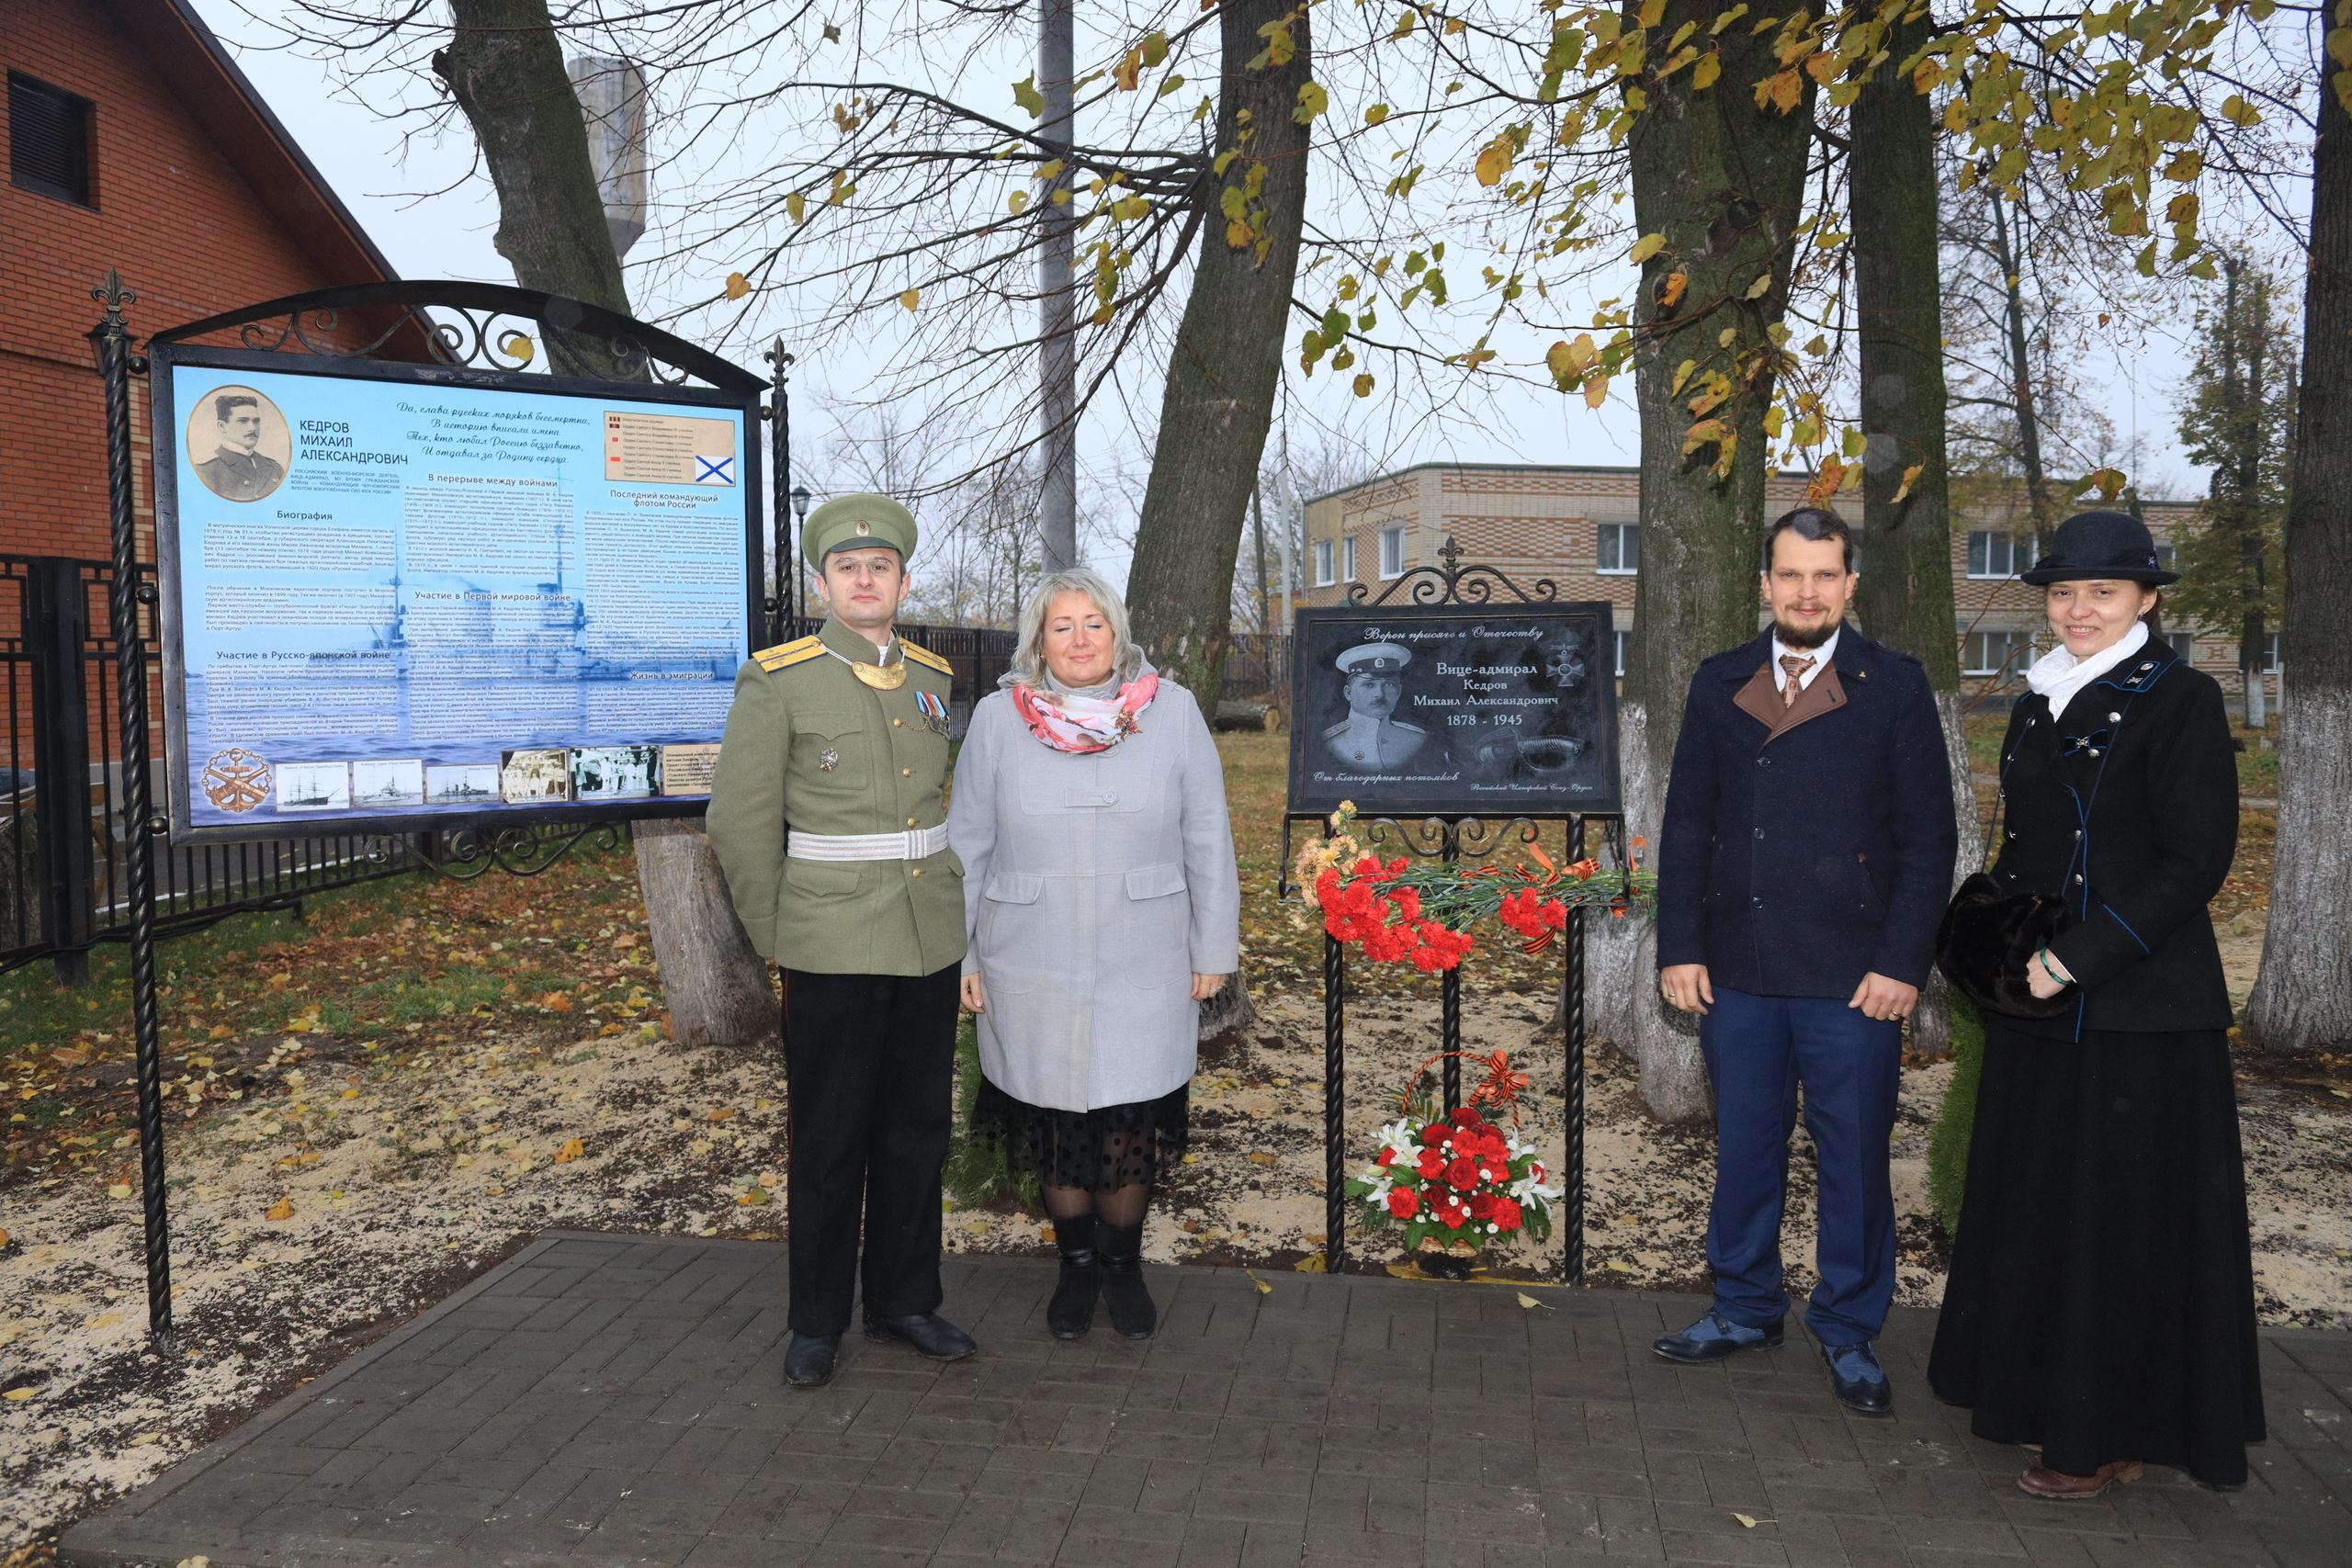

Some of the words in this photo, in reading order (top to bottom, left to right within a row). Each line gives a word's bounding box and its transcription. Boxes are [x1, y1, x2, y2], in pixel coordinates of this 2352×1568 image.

[396, 401, 417, 413] Да,
[420, 404, 448, 414] слава
[451, 408, 490, 417] русских
[492, 411, 533, 421] моряков
[535, 412, 590, 425] бессмертна,
[300, 420, 349, 434] КЕДРОВ
[431, 418, 441, 428] В
[443, 423, 488, 432] историю
[491, 423, 529, 434] вписали
[300, 434, 353, 447] МИХАИЛ
[406, 431, 432, 443] Тех,
[434, 433, 453, 442] кто
[457, 434, 487, 445] любил
[489, 435, 527, 447] Россию
[530, 438, 583, 452] беззаветно,
[300, 449, 408, 465] АЛЕКСАНДРОВИЧ
[422, 446, 434, 456] И
[435, 448, 480, 458] отдавал
[481, 452, 492, 461] за
[495, 450, 534, 463] Родину
[437, 475, 483, 485] перерыве
[486, 478, 515, 487] между
[519, 479, 558, 487] войнами
[610, 490, 658, 500] Последний
[660, 493, 718, 502] командующий
[633, 500, 665, 508] флотом
[667, 501, 696, 509] России
[277, 510, 333, 521] Биография
[414, 591, 452, 600] Участие
[464, 592, 498, 603] Первой
[501, 592, 541, 603] мировой
[544, 593, 571, 602] войне
[1363, 626, 1406, 643] Верен
[1408, 630, 1455, 643] присяге
[1471, 626, 1544, 640] Отечеству
[216, 651, 258, 660] Участие
[271, 651, 357, 661] Русско-японской
[630, 671, 659, 680] Жизнь
[668, 672, 713, 681] эмиграции
[1436, 662, 1538, 677] Вице-адмирал
[1463, 679, 1508, 692] Кедров
[1413, 694, 1461, 706] Михаил
[1465, 694, 1559, 707] Александрович
[1447, 715, 1476, 726] 1878
[1493, 714, 1522, 726] 1945
[1313, 771, 1333, 782] От
[1335, 773, 1402, 785] благодарных
[1405, 772, 1460, 781] потомков
